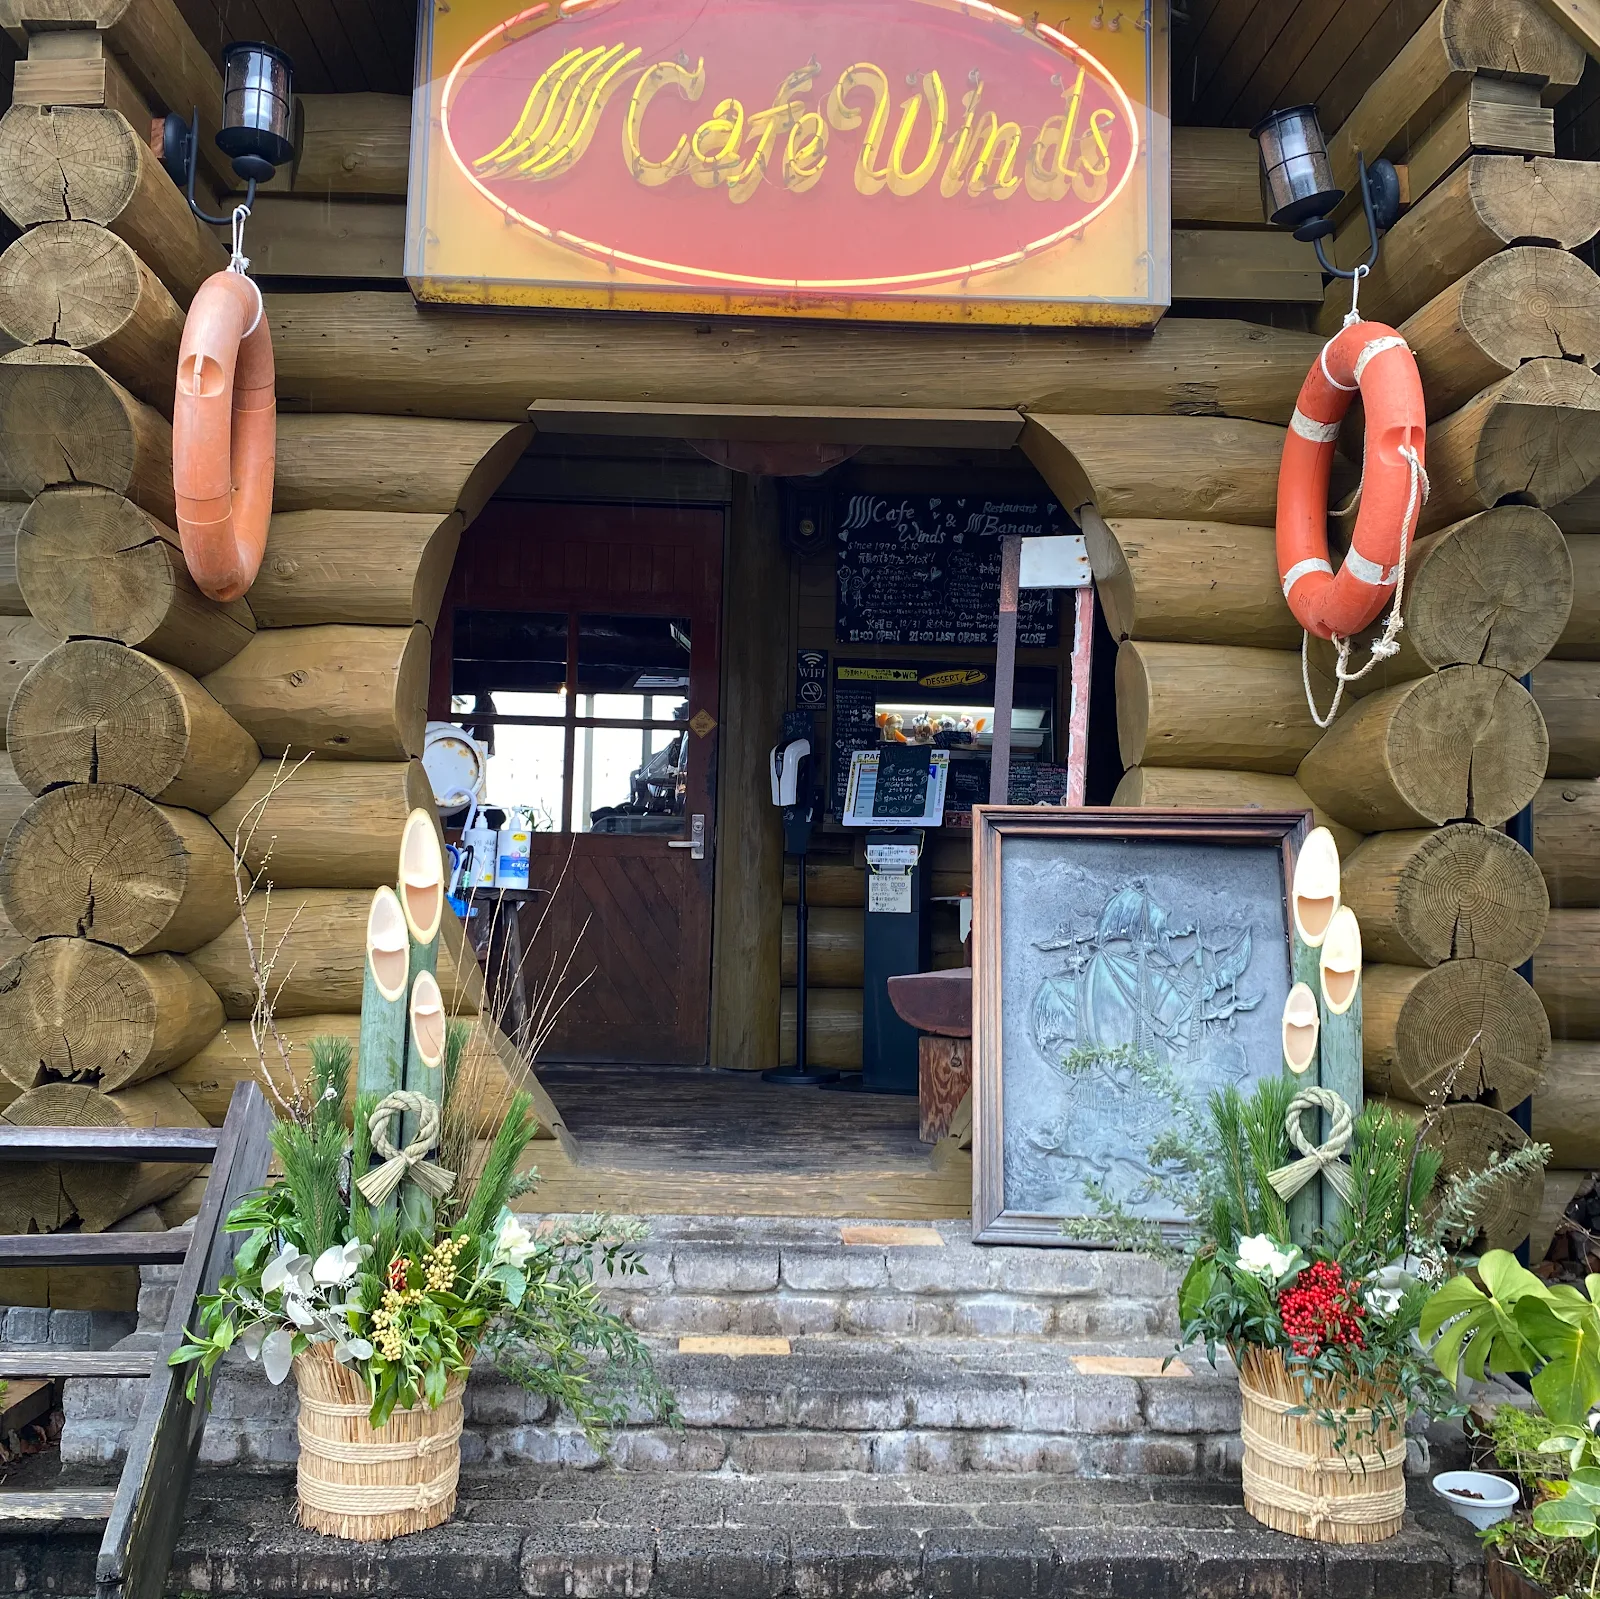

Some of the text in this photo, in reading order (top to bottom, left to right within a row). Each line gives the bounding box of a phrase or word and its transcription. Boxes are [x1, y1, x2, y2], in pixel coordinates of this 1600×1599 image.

[827, 61, 1116, 203] Winds
[873, 500, 915, 528] Cafe
[983, 501, 1038, 513] Restaurant
[946, 513, 957, 527] &
[980, 515, 1042, 536] Banana
[898, 521, 946, 544] Winds
[847, 541, 872, 550] since
[874, 542, 897, 551] 1990
[935, 631, 956, 643] LAST
[957, 632, 987, 643] ORDER
[1020, 633, 1047, 644] CLOSE
[925, 673, 960, 686] DESSERT
